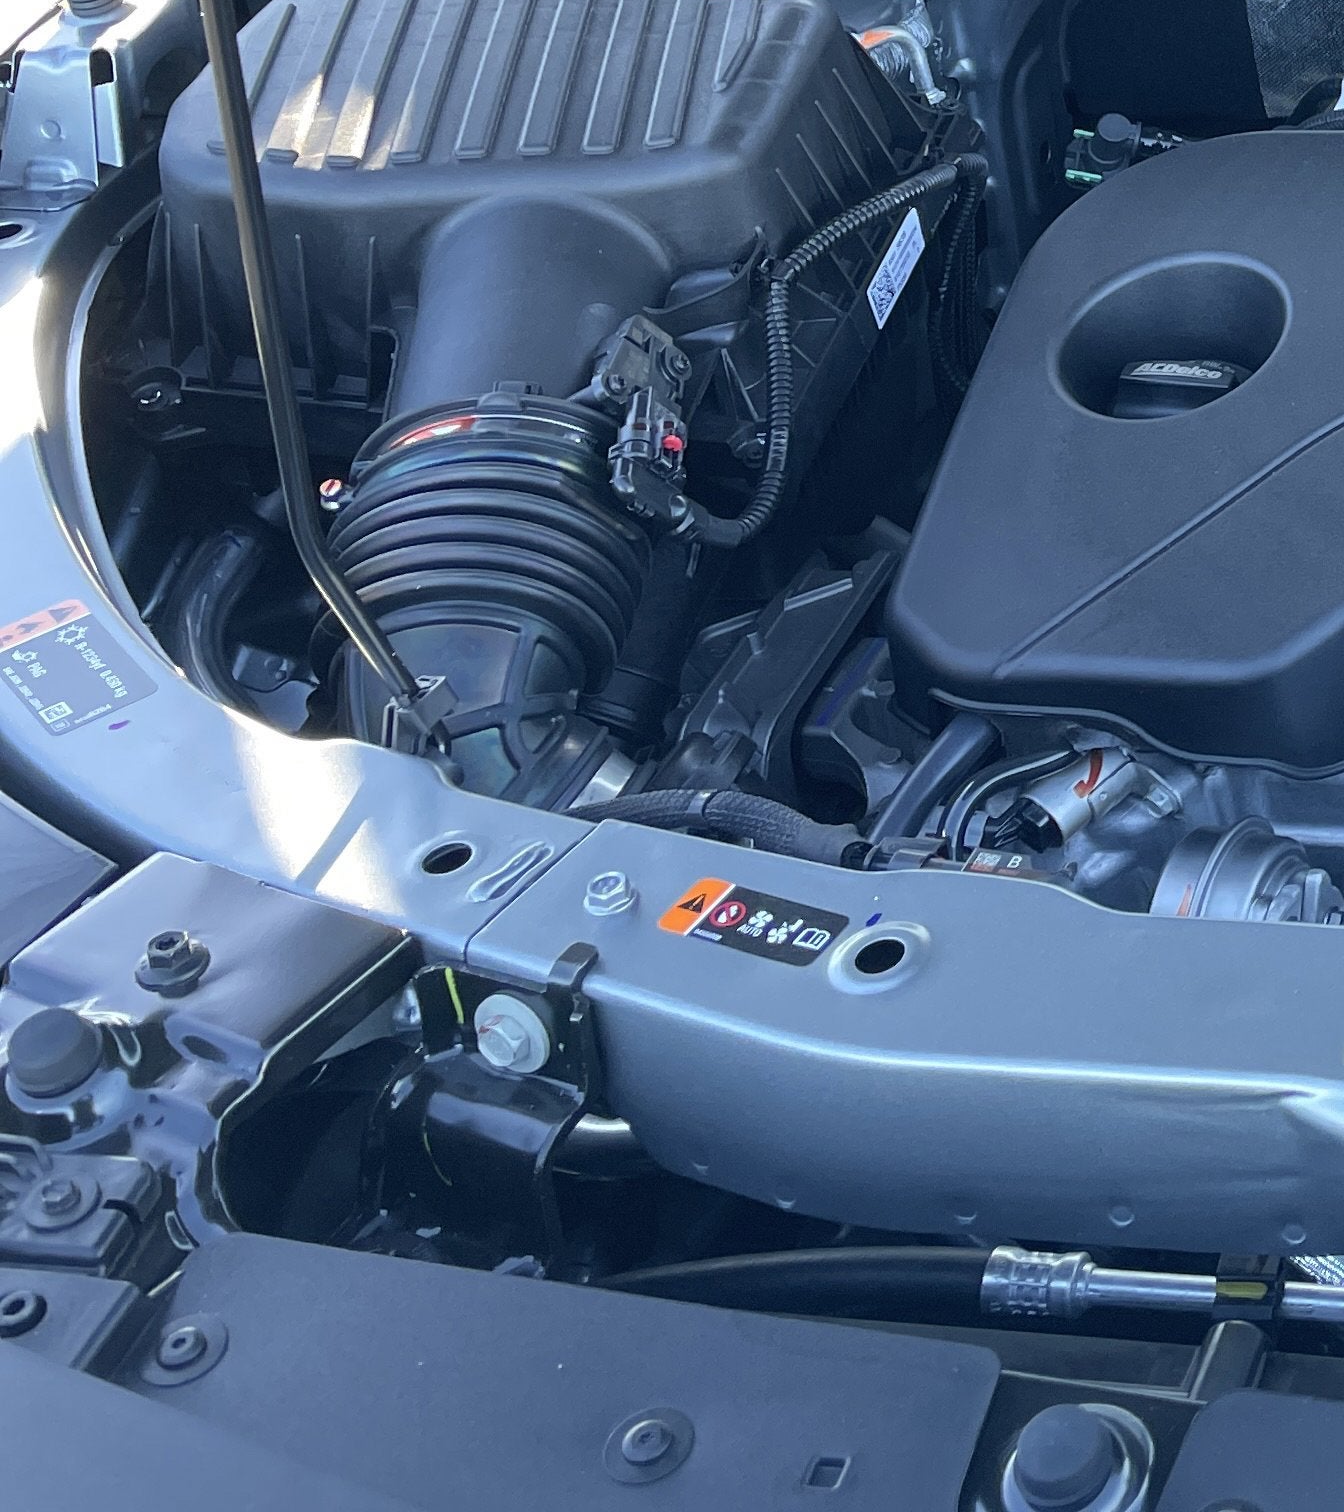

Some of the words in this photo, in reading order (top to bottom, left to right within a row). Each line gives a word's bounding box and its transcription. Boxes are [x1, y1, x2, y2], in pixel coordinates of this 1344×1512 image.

[1131, 361, 1222, 379] ACDelco
[1006, 855, 1023, 869] B
[737, 922, 763, 938] AUTO
